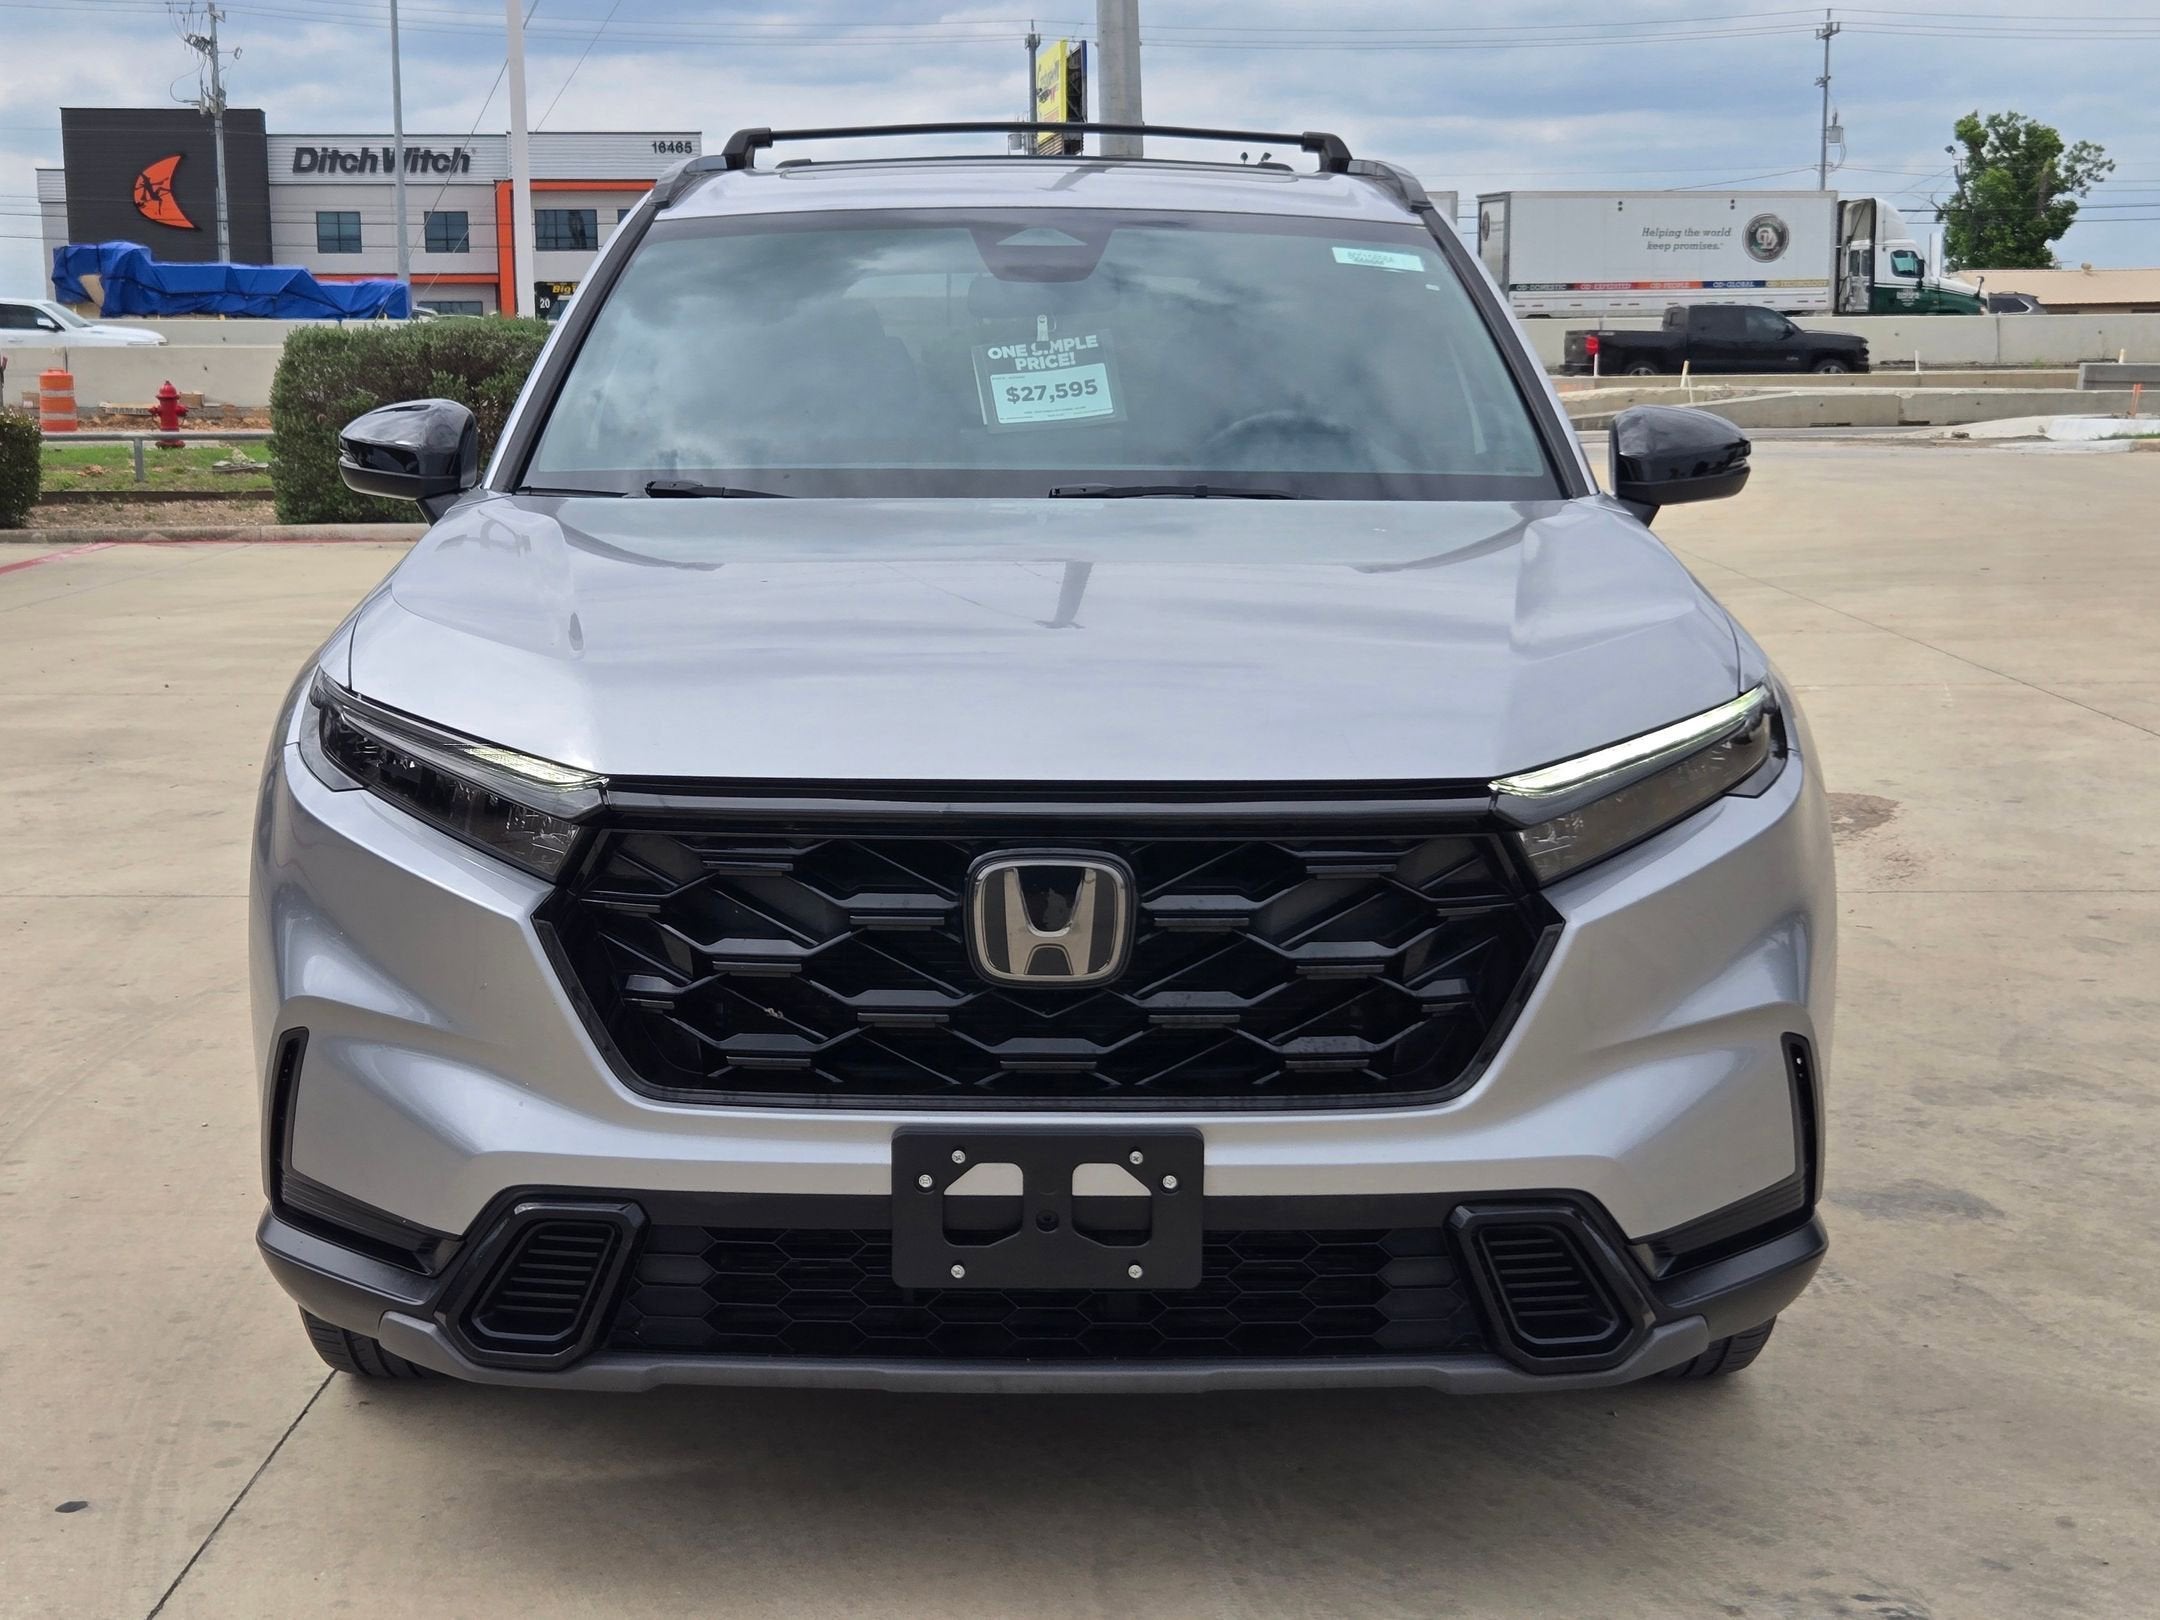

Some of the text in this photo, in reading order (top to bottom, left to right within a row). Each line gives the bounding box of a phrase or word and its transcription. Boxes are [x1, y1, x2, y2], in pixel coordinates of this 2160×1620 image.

[651, 140, 693, 154] 16465
[292, 147, 471, 174] Ditch Witch
[1642, 227, 1732, 239] Helping the world
[1646, 241, 1672, 253] keep
[540, 297, 551, 309] 20
[987, 334, 1099, 360] ONE SMPLE
[1014, 351, 1076, 371] PRICE!
[1006, 378, 1098, 405] $27,595
